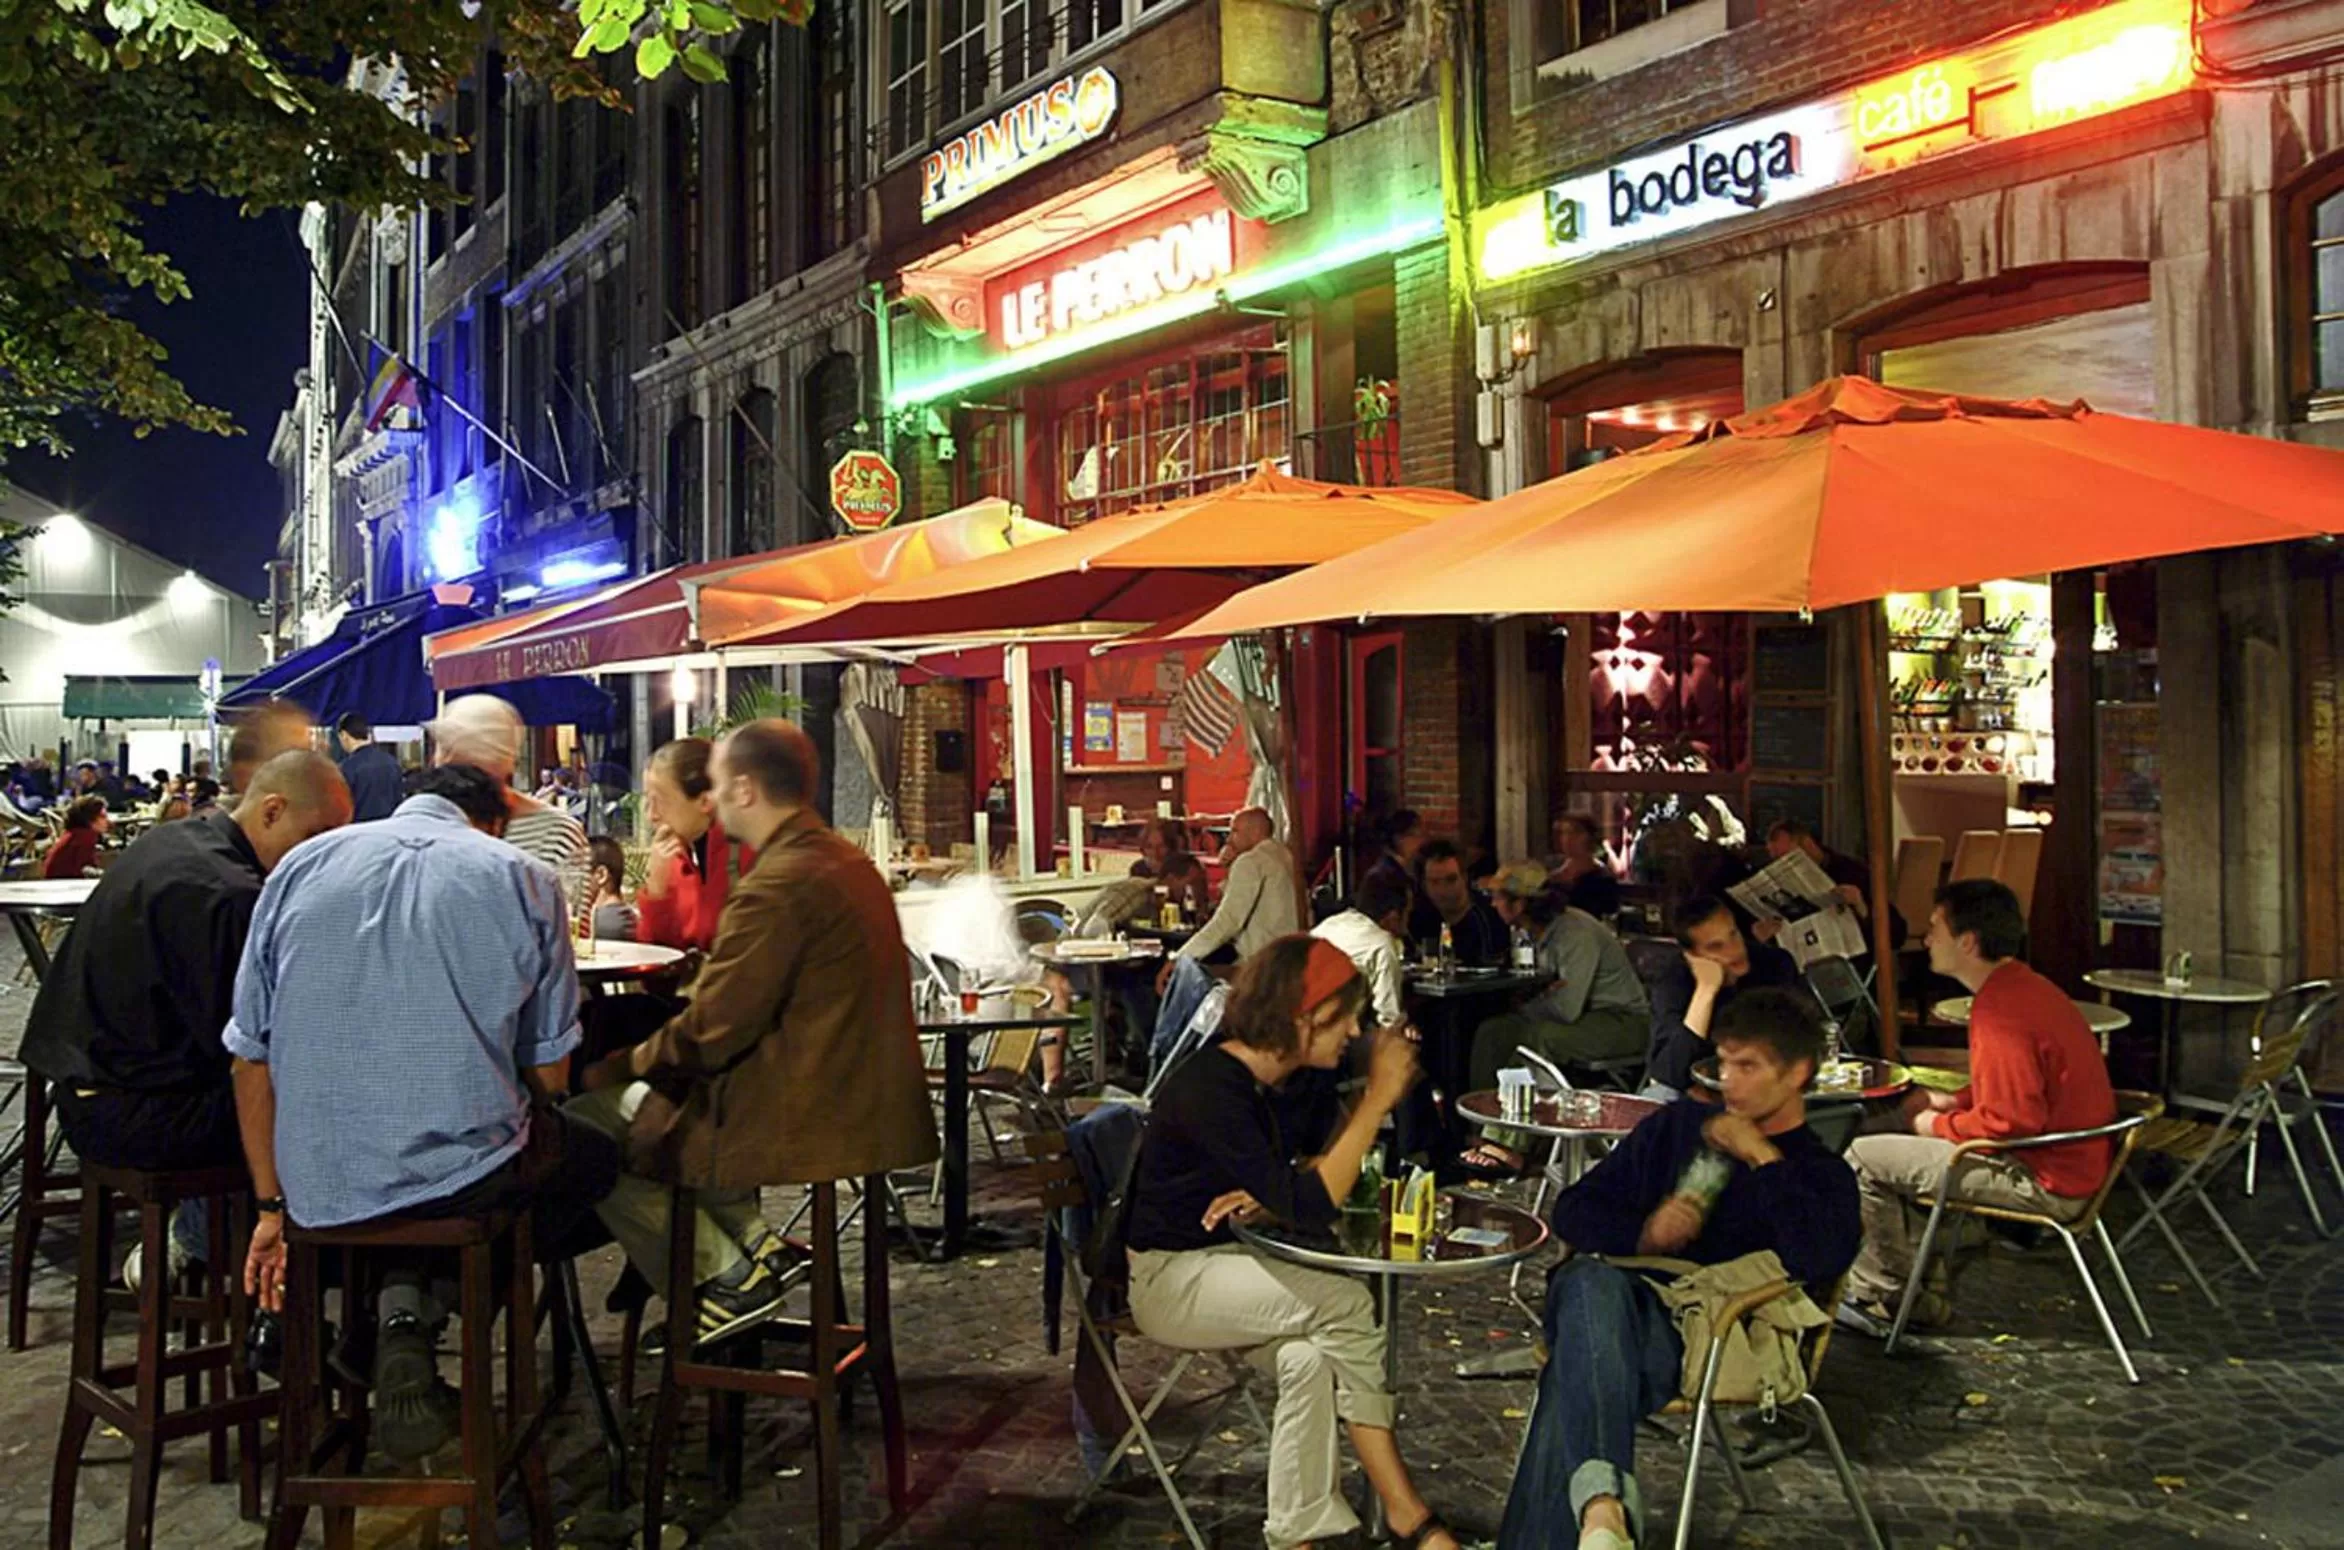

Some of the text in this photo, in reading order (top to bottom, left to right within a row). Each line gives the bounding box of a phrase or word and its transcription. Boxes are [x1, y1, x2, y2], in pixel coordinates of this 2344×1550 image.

[922, 76, 1074, 203] PRIMUS
[1545, 190, 1581, 247] la
[1609, 131, 1797, 227] bodega
[1858, 67, 1952, 138] café
[1001, 209, 1232, 348] LE PERRON
[523, 634, 590, 675] PERRON
